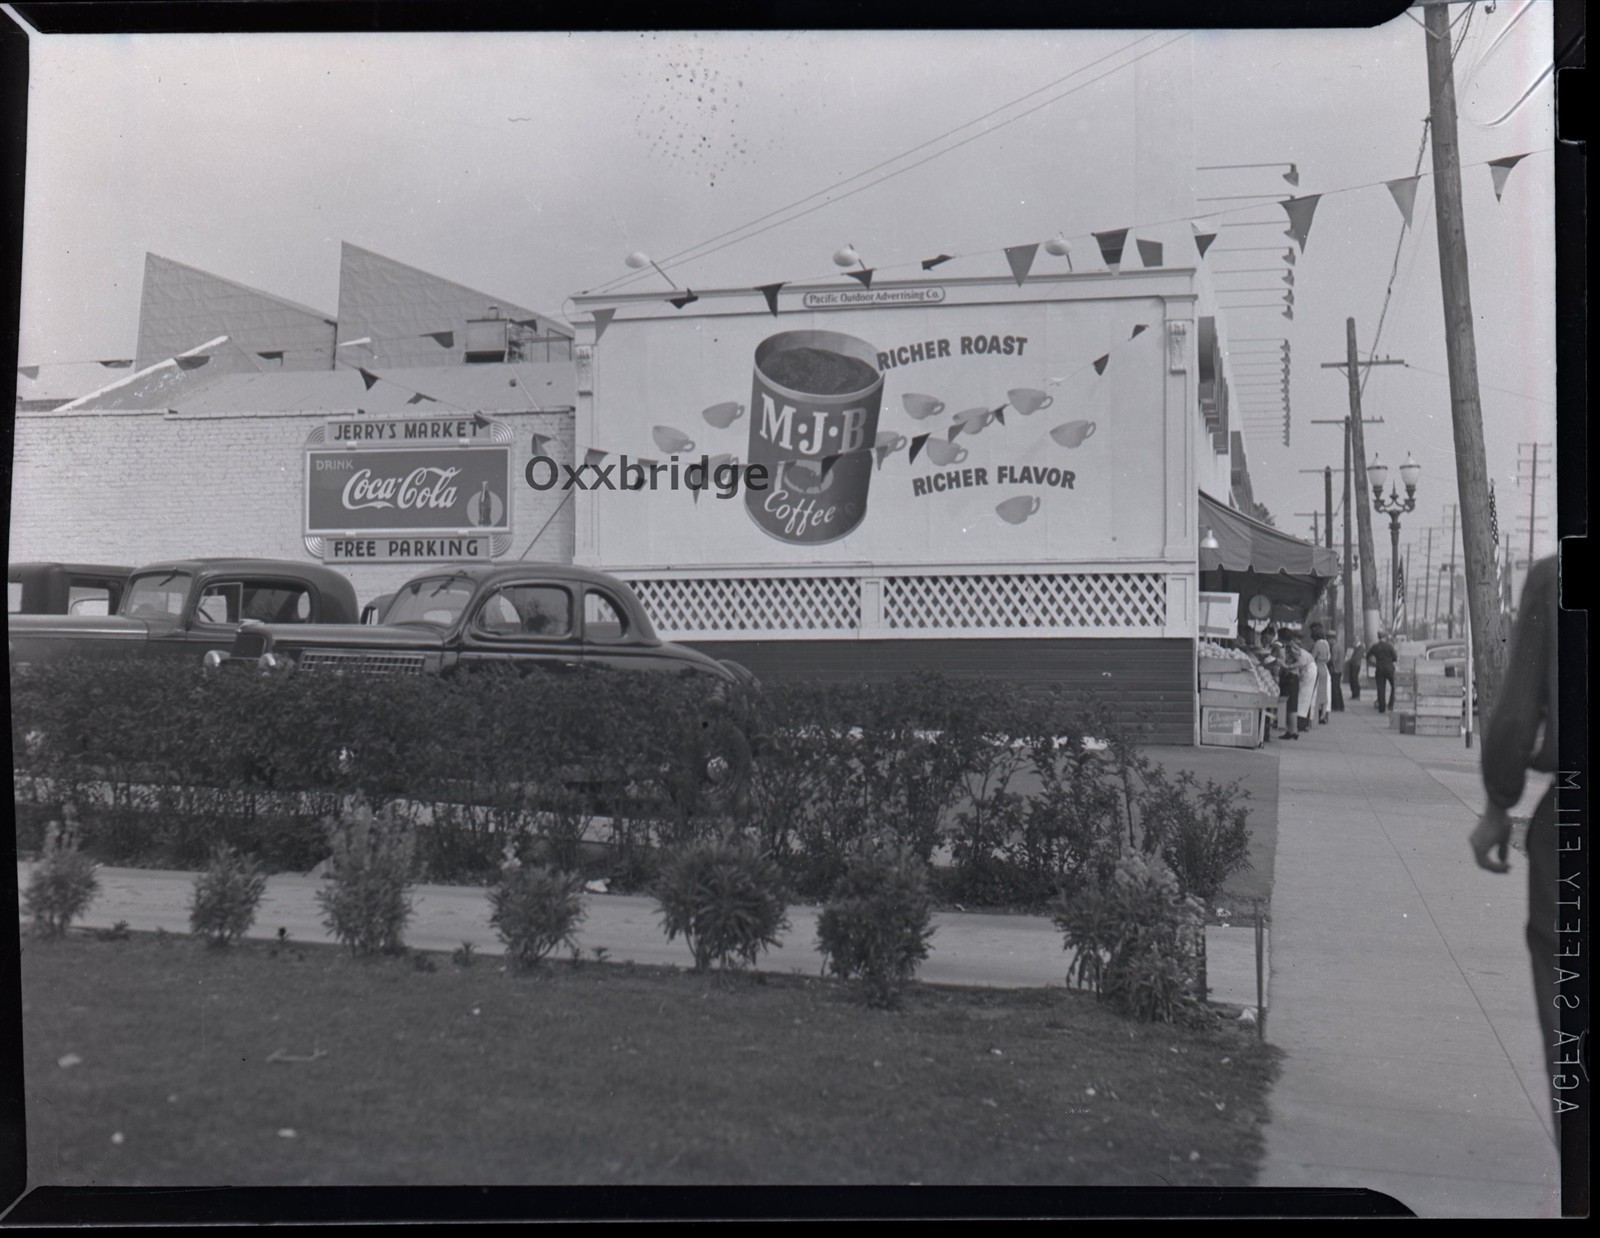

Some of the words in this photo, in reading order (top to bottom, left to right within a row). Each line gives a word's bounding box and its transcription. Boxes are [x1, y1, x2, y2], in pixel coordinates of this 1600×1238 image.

[809, 293, 838, 304] Pacific
[840, 292, 875, 303] Outdoor
[875, 290, 925, 302] Advertising
[926, 289, 940, 299] Co.
[876, 338, 951, 372] RICHER
[960, 334, 1028, 357] ROAST
[334, 422, 397, 440] JERRY'S
[404, 420, 478, 438] MARKET
[315, 459, 354, 471] DRINK
[912, 467, 989, 497] RICHER
[997, 465, 1076, 490] FLAVOR
[764, 489, 836, 536] Coffee
[334, 541, 376, 557] FREE
[389, 539, 478, 557] PARKING
